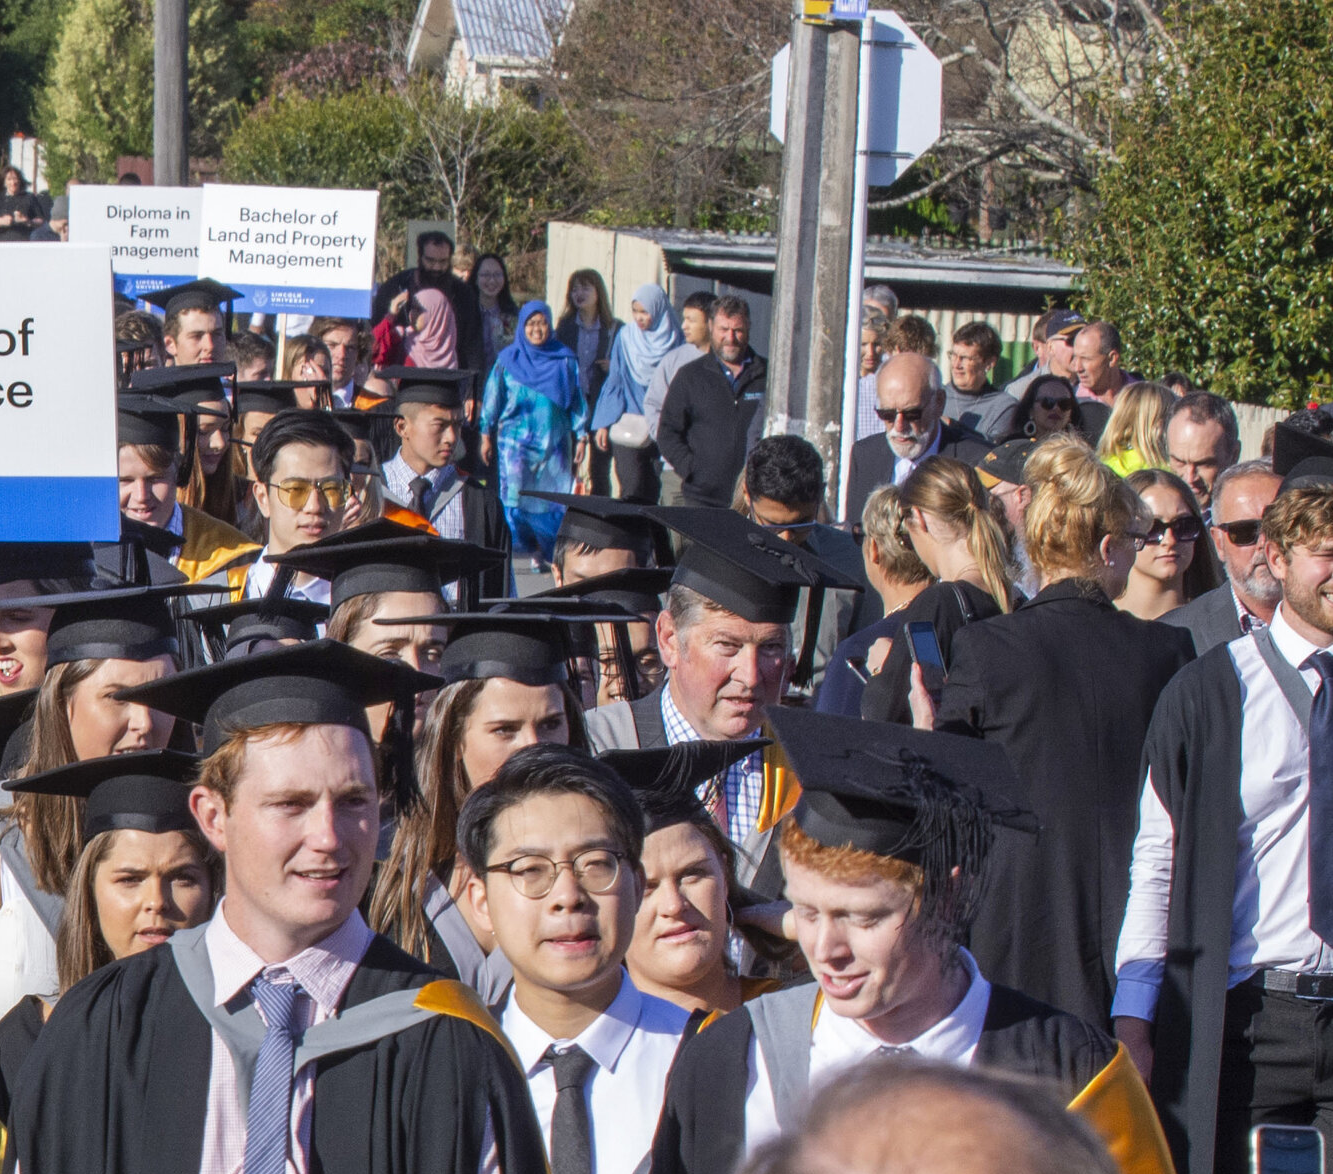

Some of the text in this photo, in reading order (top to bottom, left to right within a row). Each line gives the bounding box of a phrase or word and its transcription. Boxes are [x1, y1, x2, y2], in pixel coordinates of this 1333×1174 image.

[107, 205, 191, 221] Diploma in
[240, 207, 338, 225] Bachelor of
[131, 225, 169, 238] Farm
[208, 227, 366, 251] Land and Property
[112, 245, 199, 260] anagement
[229, 249, 343, 268] Management
